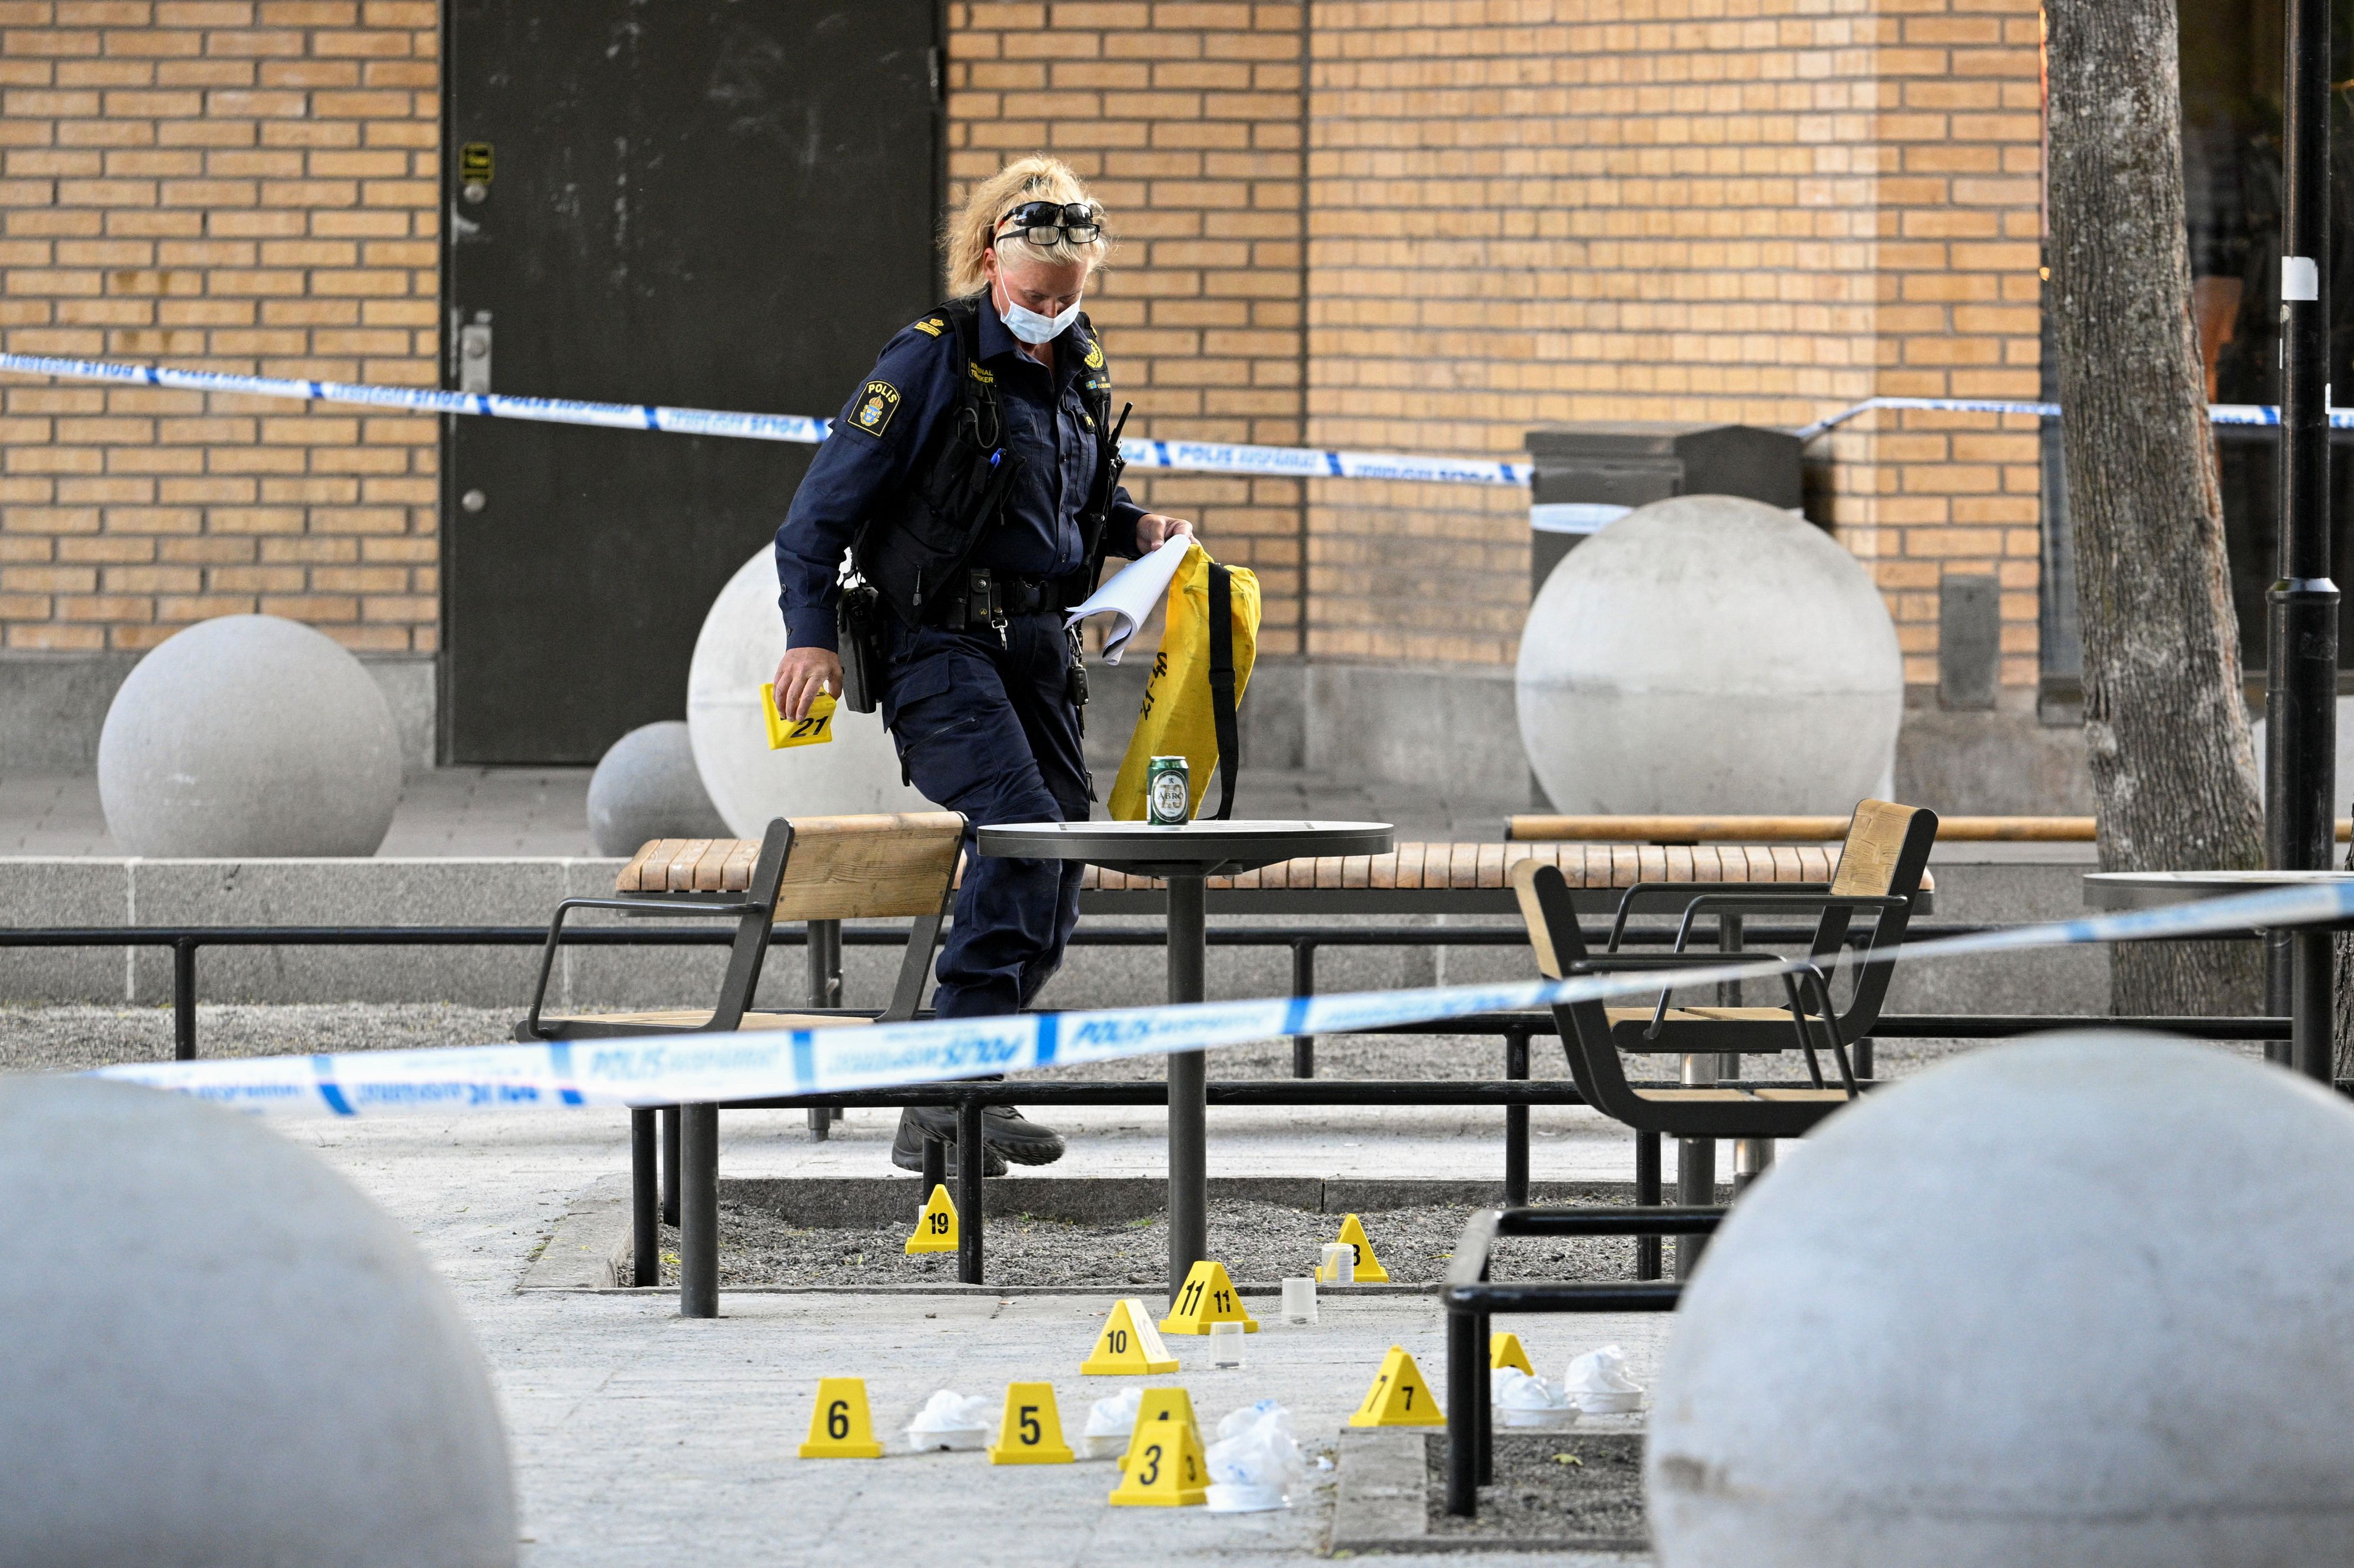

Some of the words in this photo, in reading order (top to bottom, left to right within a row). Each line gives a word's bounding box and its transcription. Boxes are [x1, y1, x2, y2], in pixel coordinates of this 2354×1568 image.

[868, 383, 897, 403] POLIS
[790, 715, 829, 738] 21
[928, 1213, 949, 1234] 19
[1180, 1280, 1205, 1316] 11
[1213, 1290, 1231, 1313] 11
[1107, 1330, 1127, 1354] 10
[1402, 1386, 1414, 1411] 7
[828, 1400, 849, 1440] 6
[1020, 1406, 1040, 1445] 5
[1139, 1444, 1162, 1486] 3
